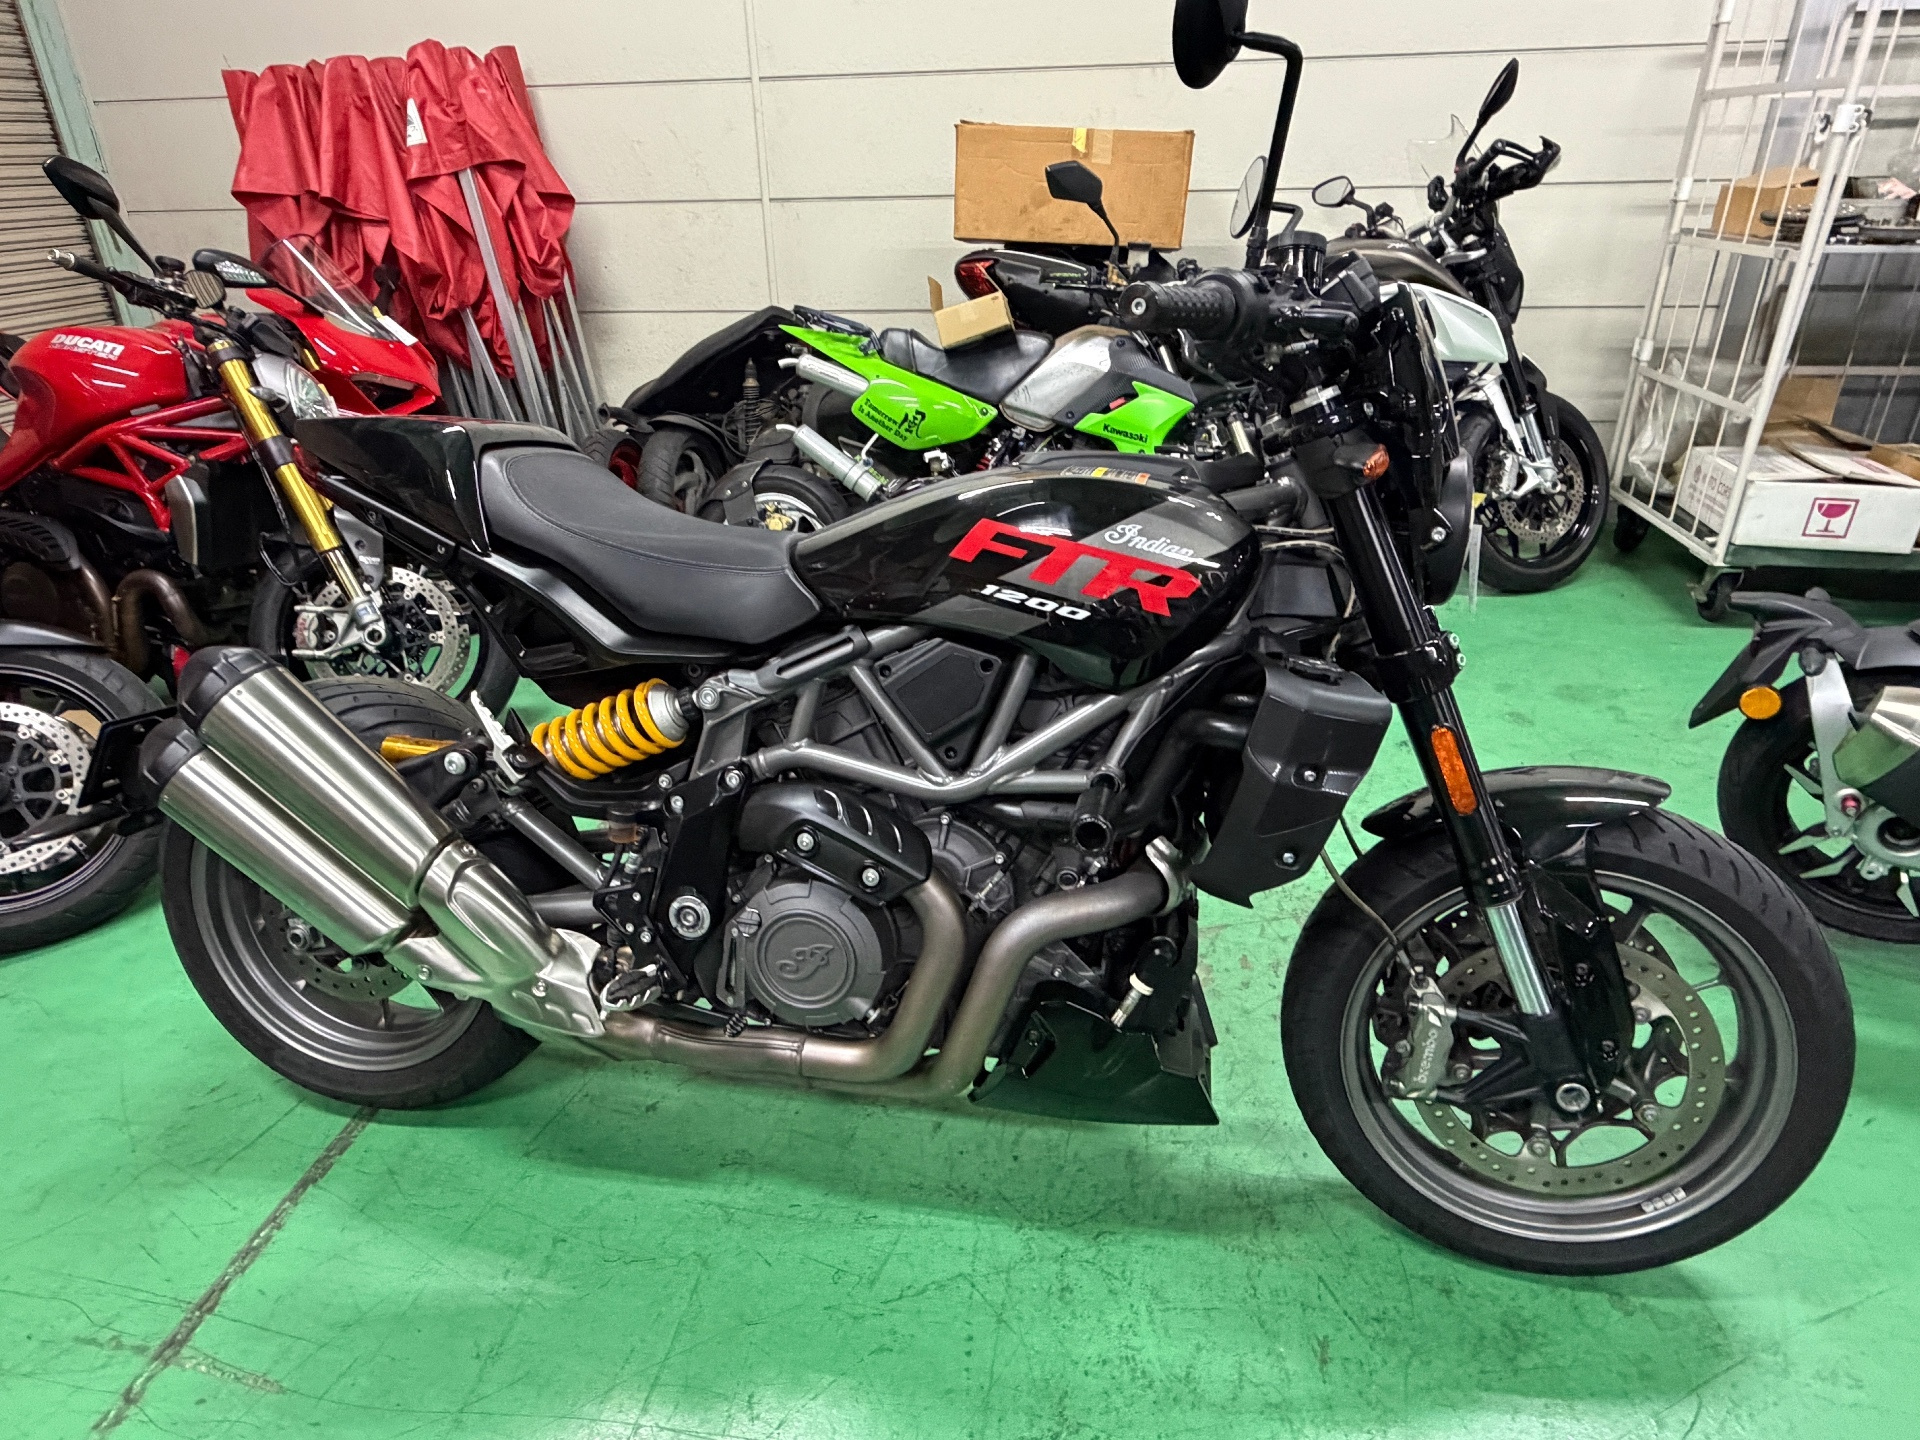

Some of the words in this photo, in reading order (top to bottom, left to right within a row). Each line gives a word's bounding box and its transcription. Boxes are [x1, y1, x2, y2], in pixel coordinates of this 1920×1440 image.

[51, 334, 125, 356] DUCATI
[865, 398, 898, 426] Tomorrow
[865, 411, 893, 432] Another
[894, 429, 907, 441] Day
[1102, 423, 1148, 443] Kawasaki
[1104, 523, 1220, 568] Indian
[948, 518, 1202, 617] FTR
[980, 584, 1091, 620] 1200
[1412, 1029, 1437, 1083] brembo
